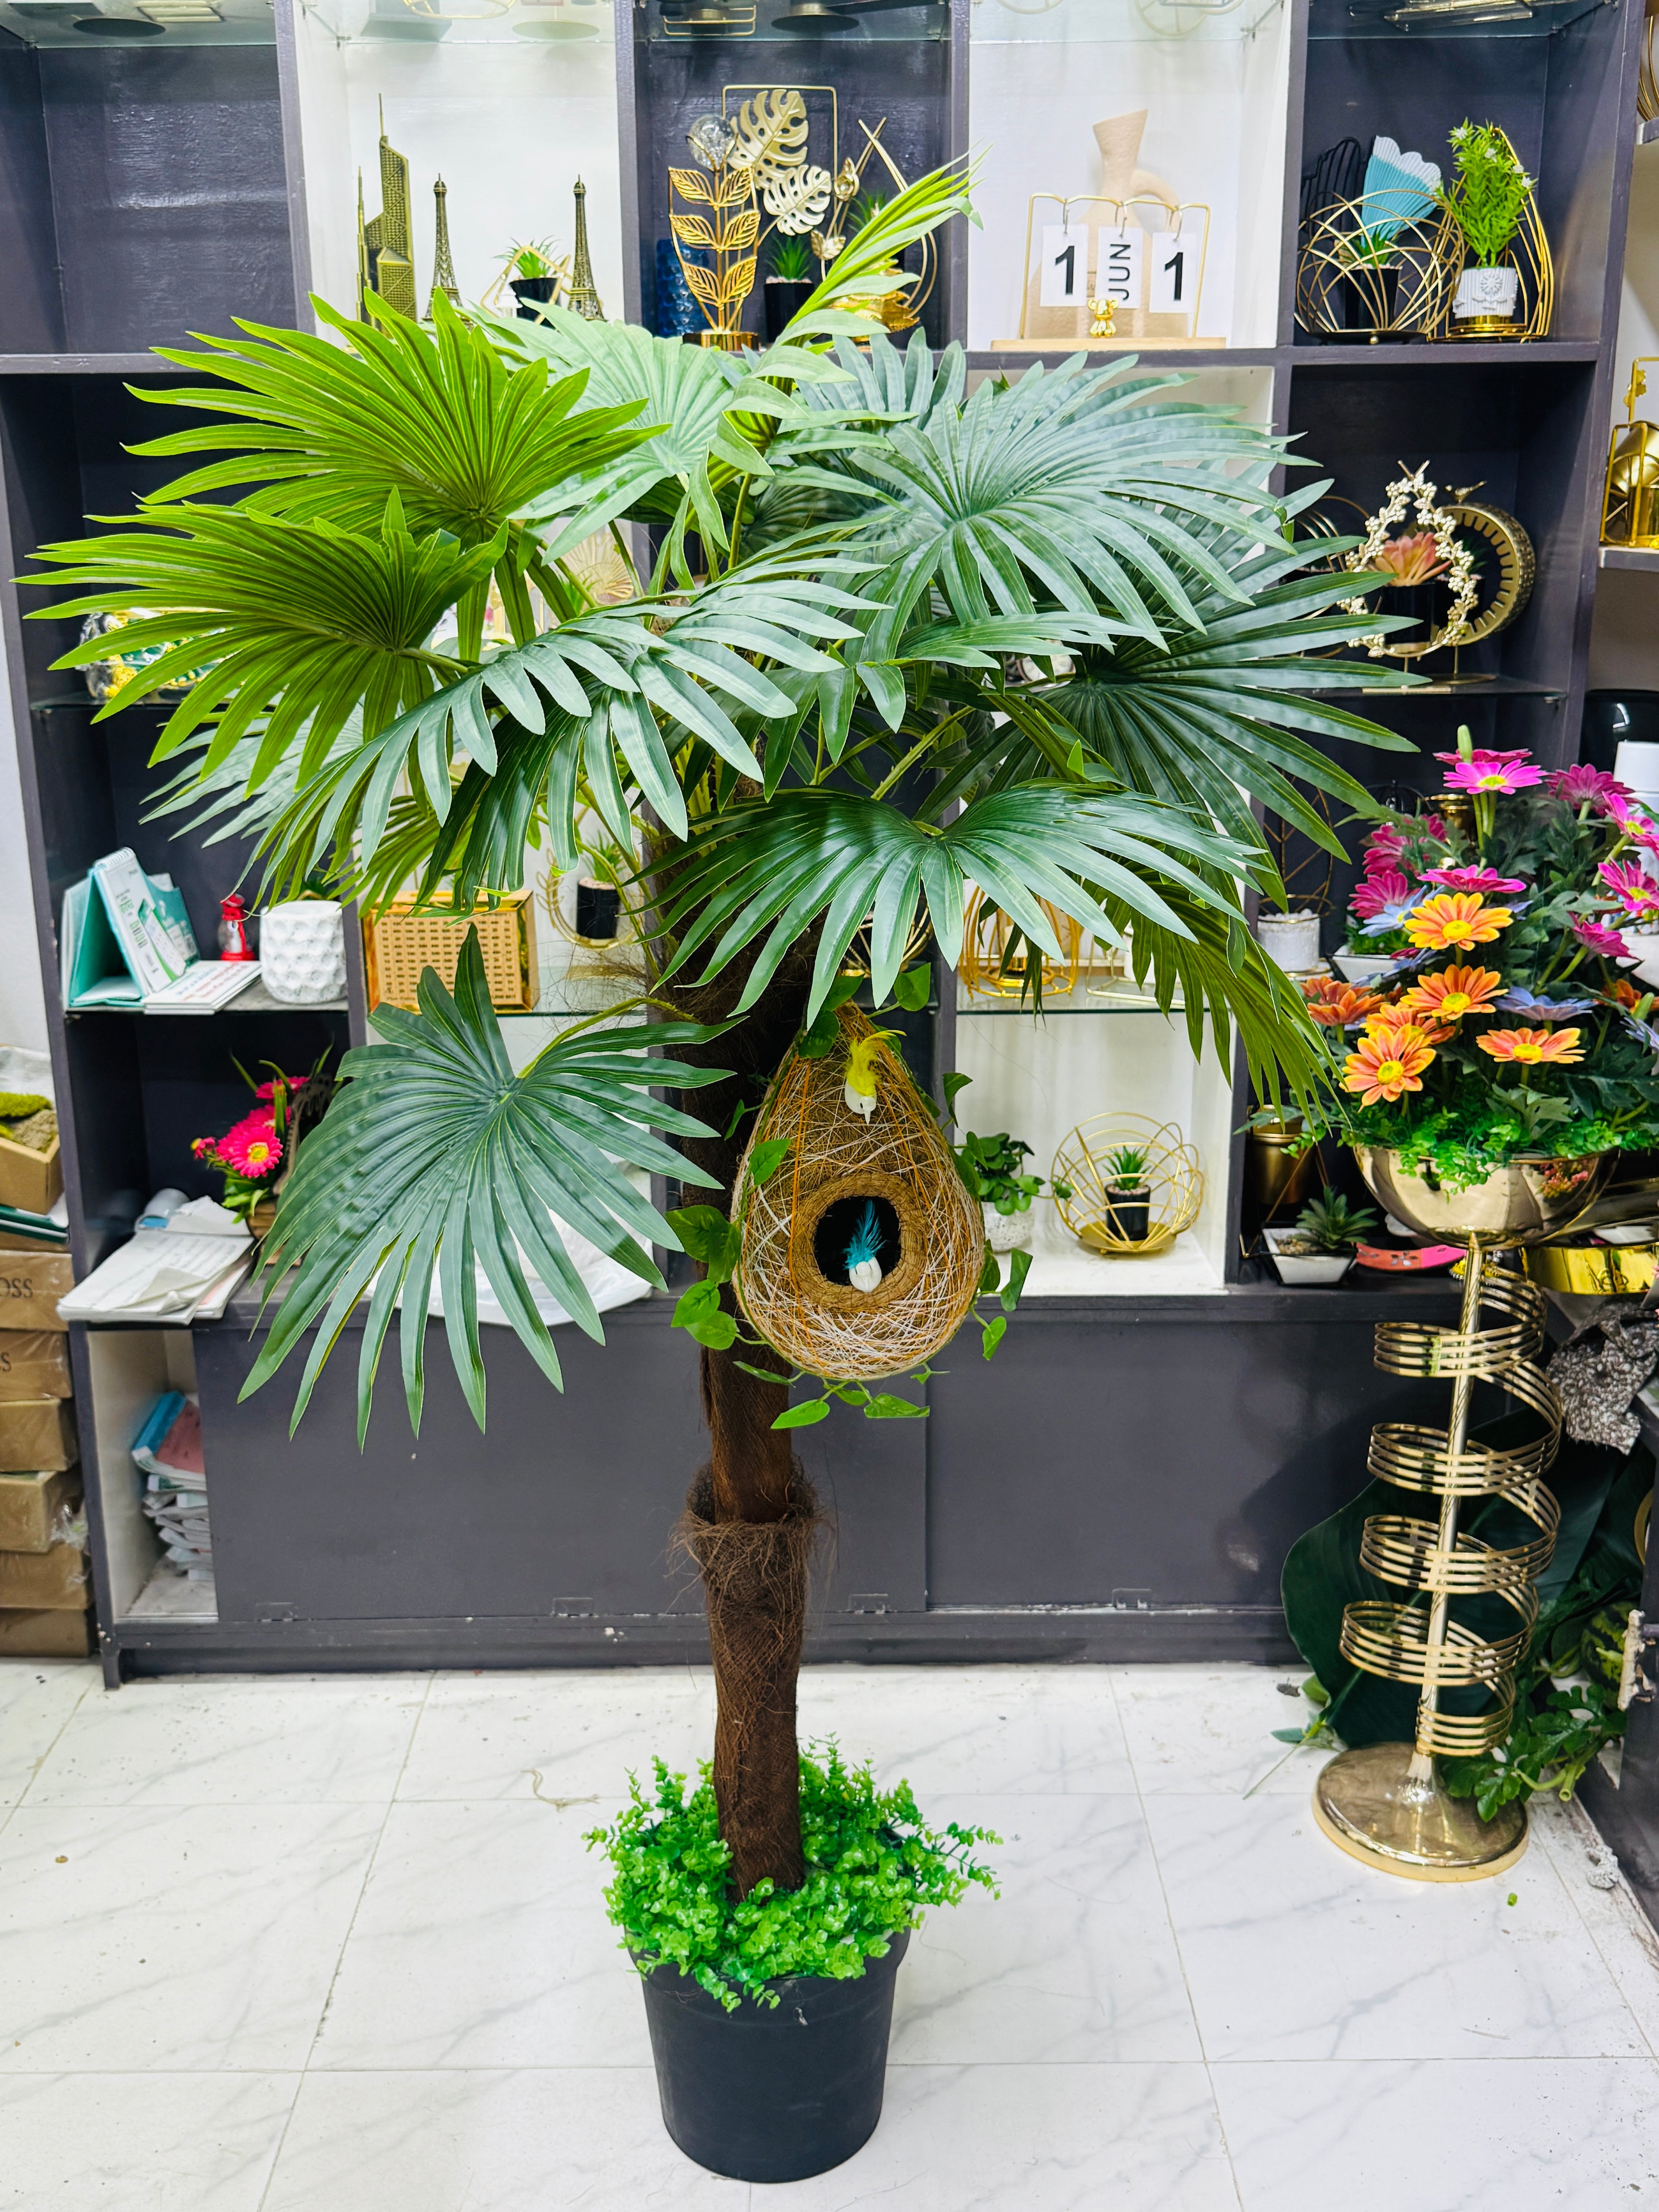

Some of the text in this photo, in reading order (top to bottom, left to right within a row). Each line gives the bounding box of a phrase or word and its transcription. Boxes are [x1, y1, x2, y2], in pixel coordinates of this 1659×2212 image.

[1055, 245, 1075, 295] 1
[1108, 244, 1131, 301] JUN
[1164, 252, 1183, 302] 1
[0, 1352, 12, 1373] S
